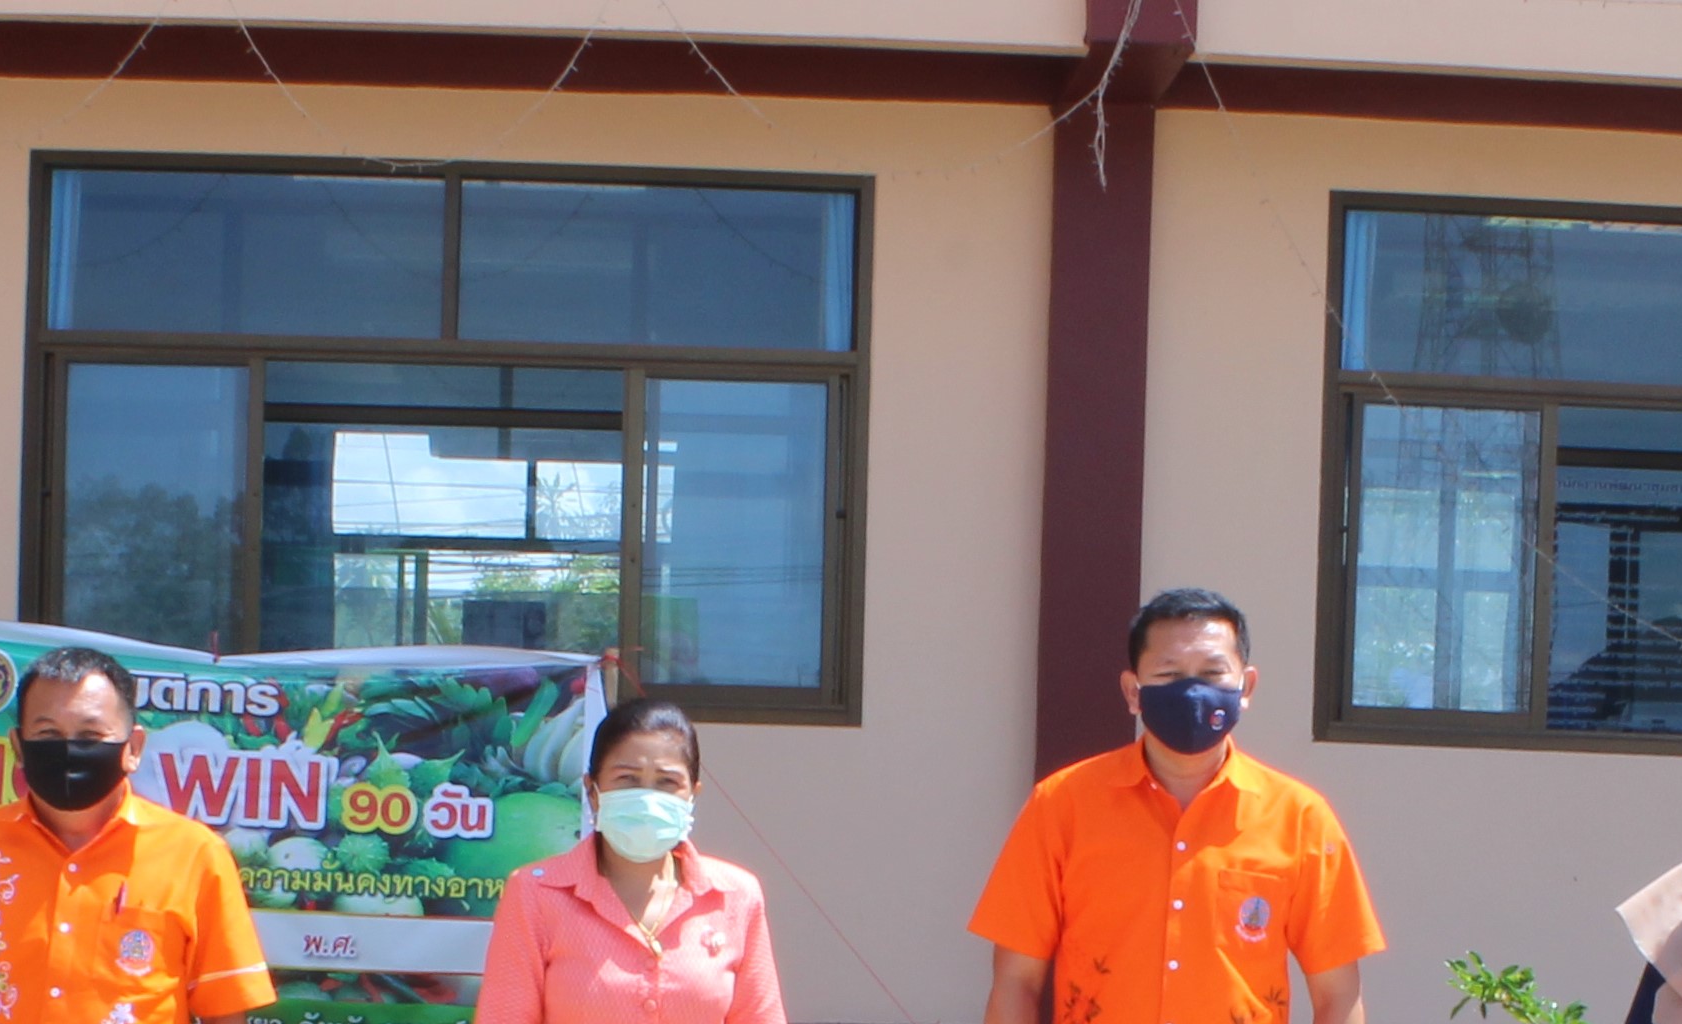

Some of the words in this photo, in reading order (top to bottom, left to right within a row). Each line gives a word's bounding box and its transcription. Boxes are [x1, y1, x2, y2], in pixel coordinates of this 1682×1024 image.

[156, 749, 324, 827] WIN
[343, 784, 416, 833] 90
[427, 784, 491, 836] วัน
[303, 933, 356, 955] พ.ศ.
